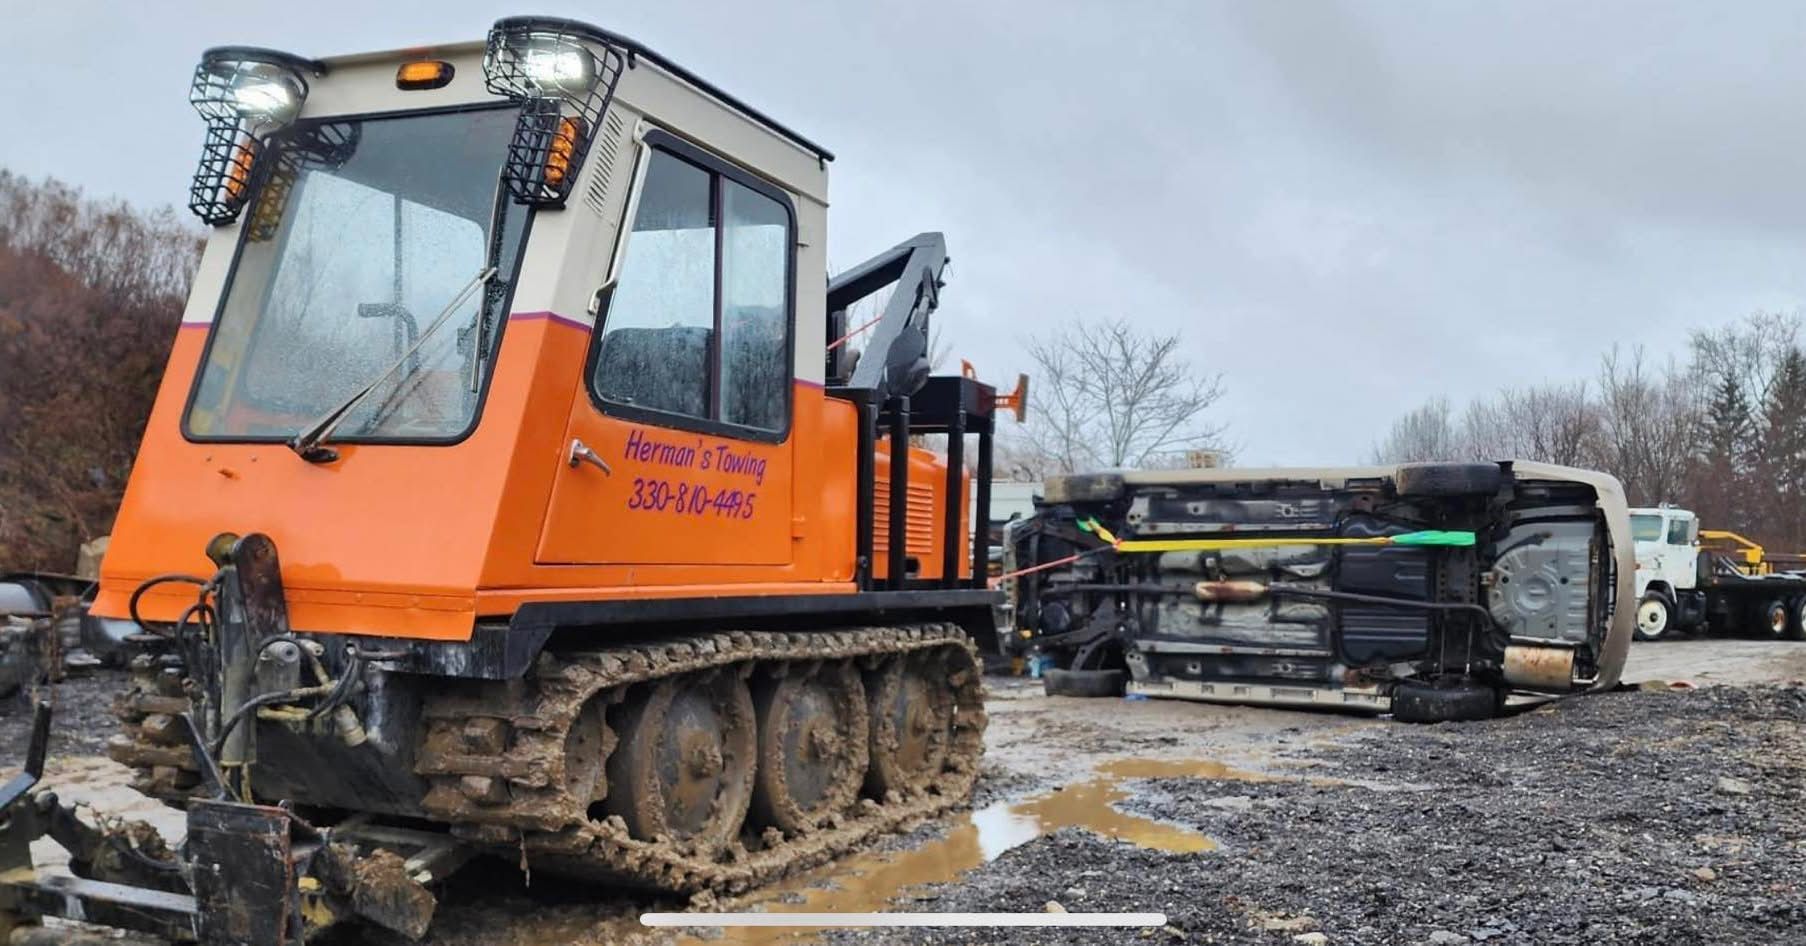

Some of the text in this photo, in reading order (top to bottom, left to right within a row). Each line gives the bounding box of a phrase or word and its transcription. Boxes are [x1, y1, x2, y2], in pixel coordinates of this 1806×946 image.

[624, 430, 767, 485] Herman's Towing
[628, 478, 756, 519] 330-810-4495
